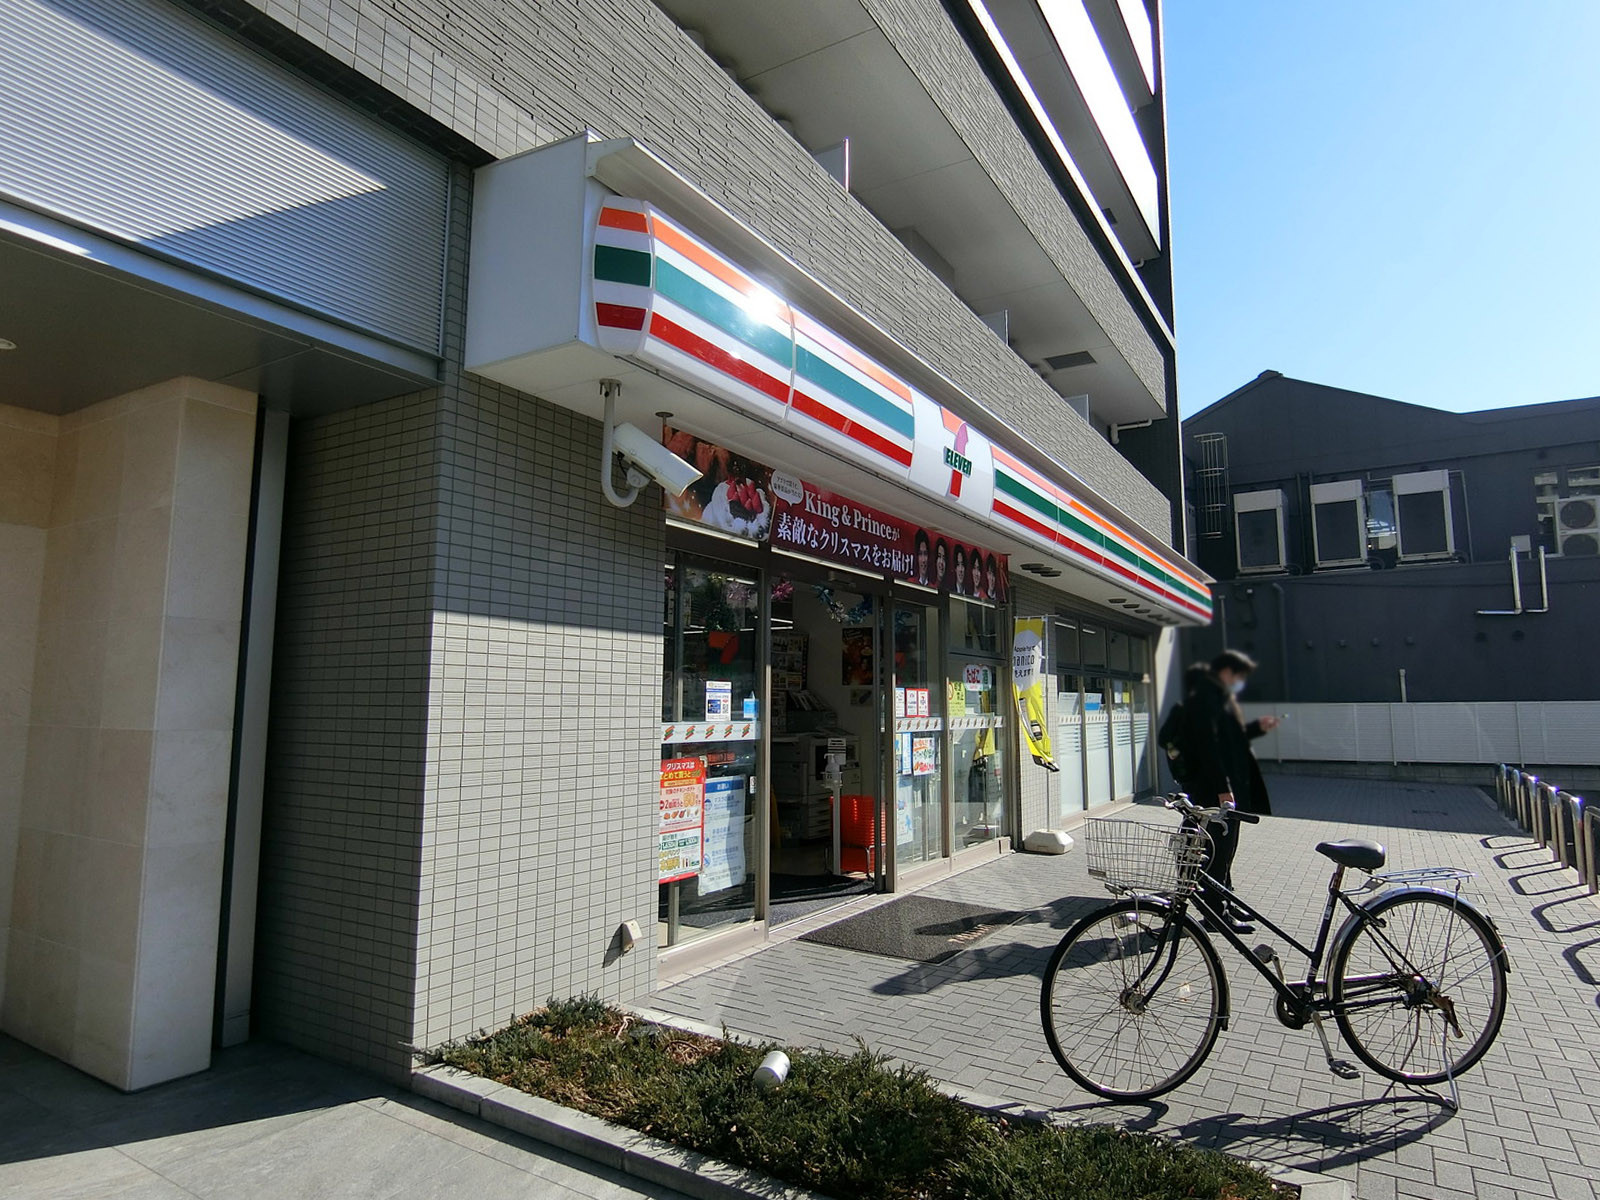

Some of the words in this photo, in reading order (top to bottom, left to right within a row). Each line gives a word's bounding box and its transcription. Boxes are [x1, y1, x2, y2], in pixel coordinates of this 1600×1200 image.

[804, 490, 840, 527] King
[777, 512, 914, 576] 素敵なクリスマスをお届け!
